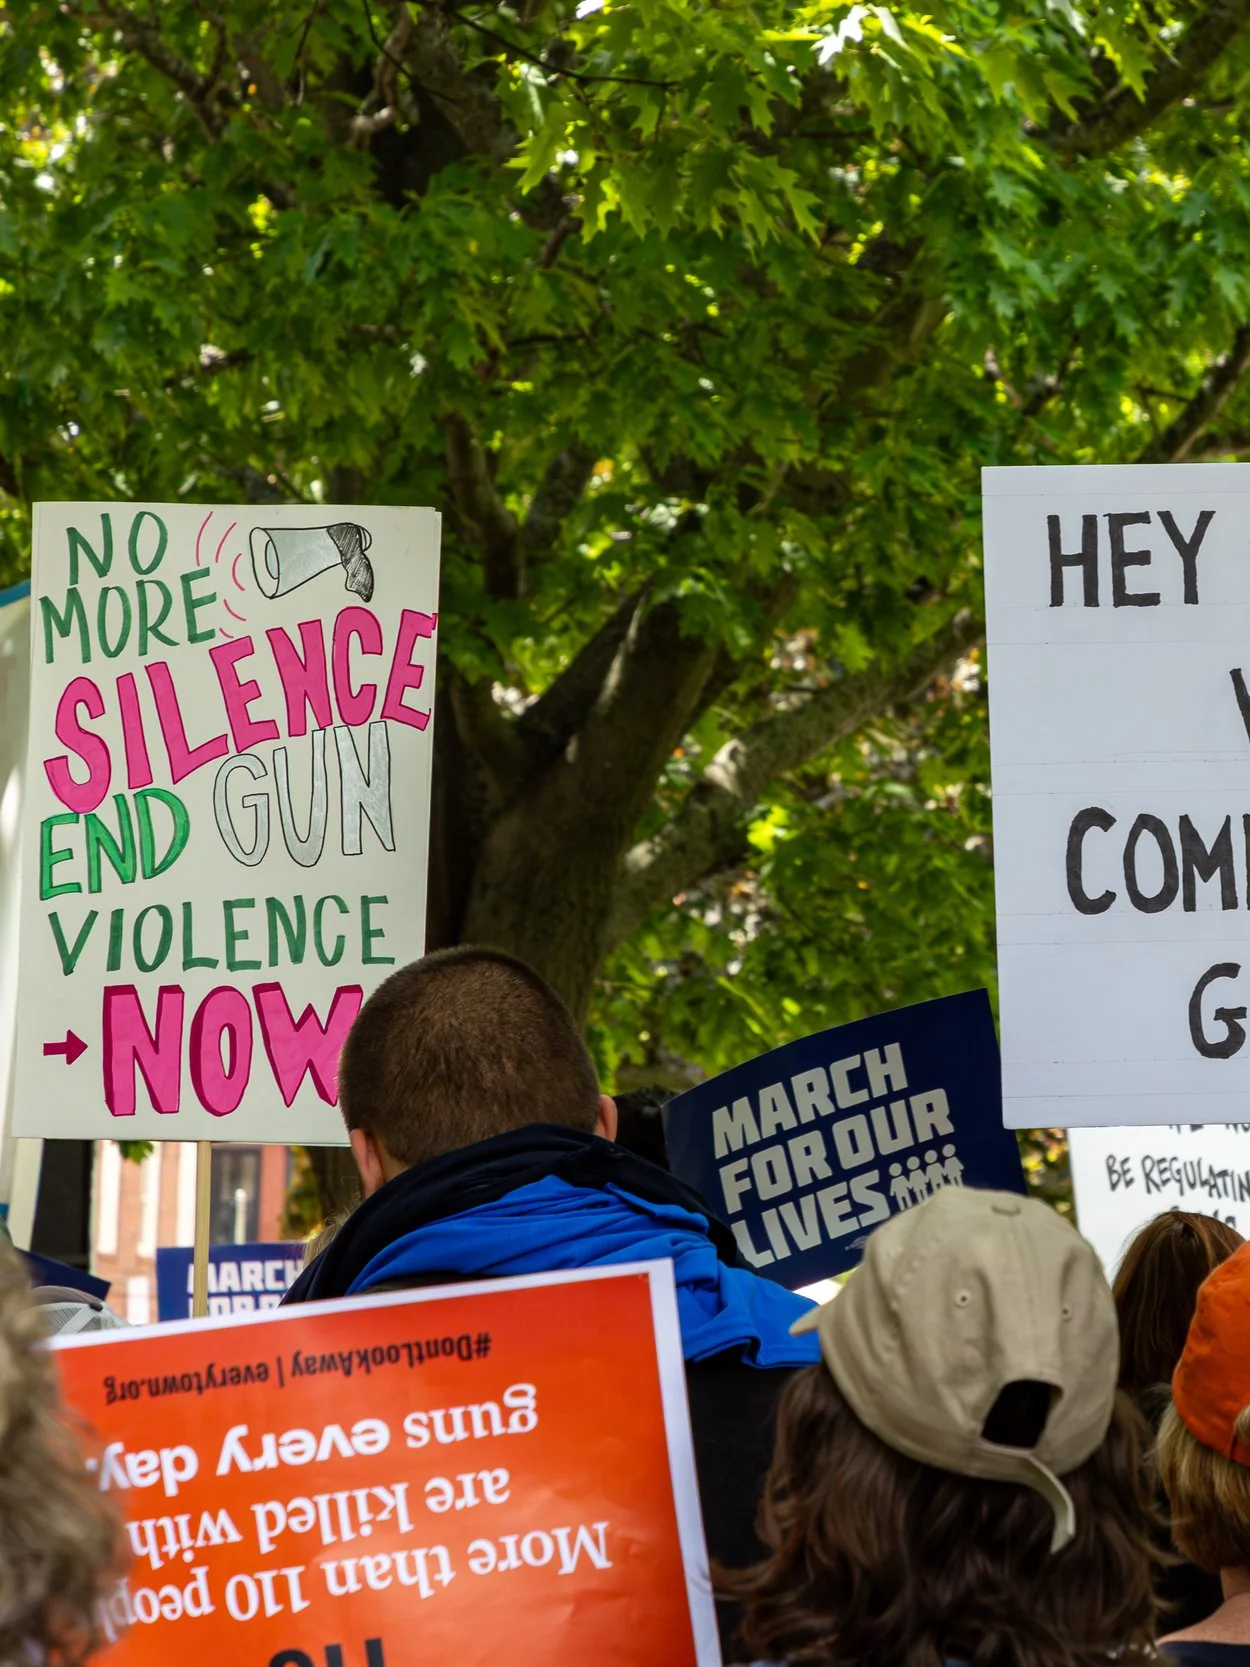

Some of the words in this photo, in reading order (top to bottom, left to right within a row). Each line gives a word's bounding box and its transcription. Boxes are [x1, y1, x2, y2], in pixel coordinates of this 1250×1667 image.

[66, 511, 168, 586] NO
[1047, 510, 1215, 608] HEY
[39, 567, 218, 664] MORE
[43, 606, 439, 815] SILENCE
[39, 787, 191, 901] END
[213, 721, 397, 868] GUN
[48, 894, 396, 977] VIOLENCE
[102, 982, 364, 1117] NOW
[711, 1042, 908, 1160] MARCH
[718, 1129, 833, 1215] FOR
[831, 1088, 955, 1170] OUR
[1105, 1154, 1134, 1192] BE
[730, 1169, 891, 1269] LIVES
[103, 1359, 270, 1406] everytown.org
[290, 1332, 493, 1378] #DontLookAway
[215, 1418, 392, 1477] every
[403, 1383, 539, 1449] guns
[250, 1482, 415, 1553] killed
[424, 1467, 511, 1513] are
[125, 1508, 242, 1571] with
[322, 1544, 457, 1600] than
[468, 1521, 614, 1576] More
[225, 1564, 311, 1622] 110
